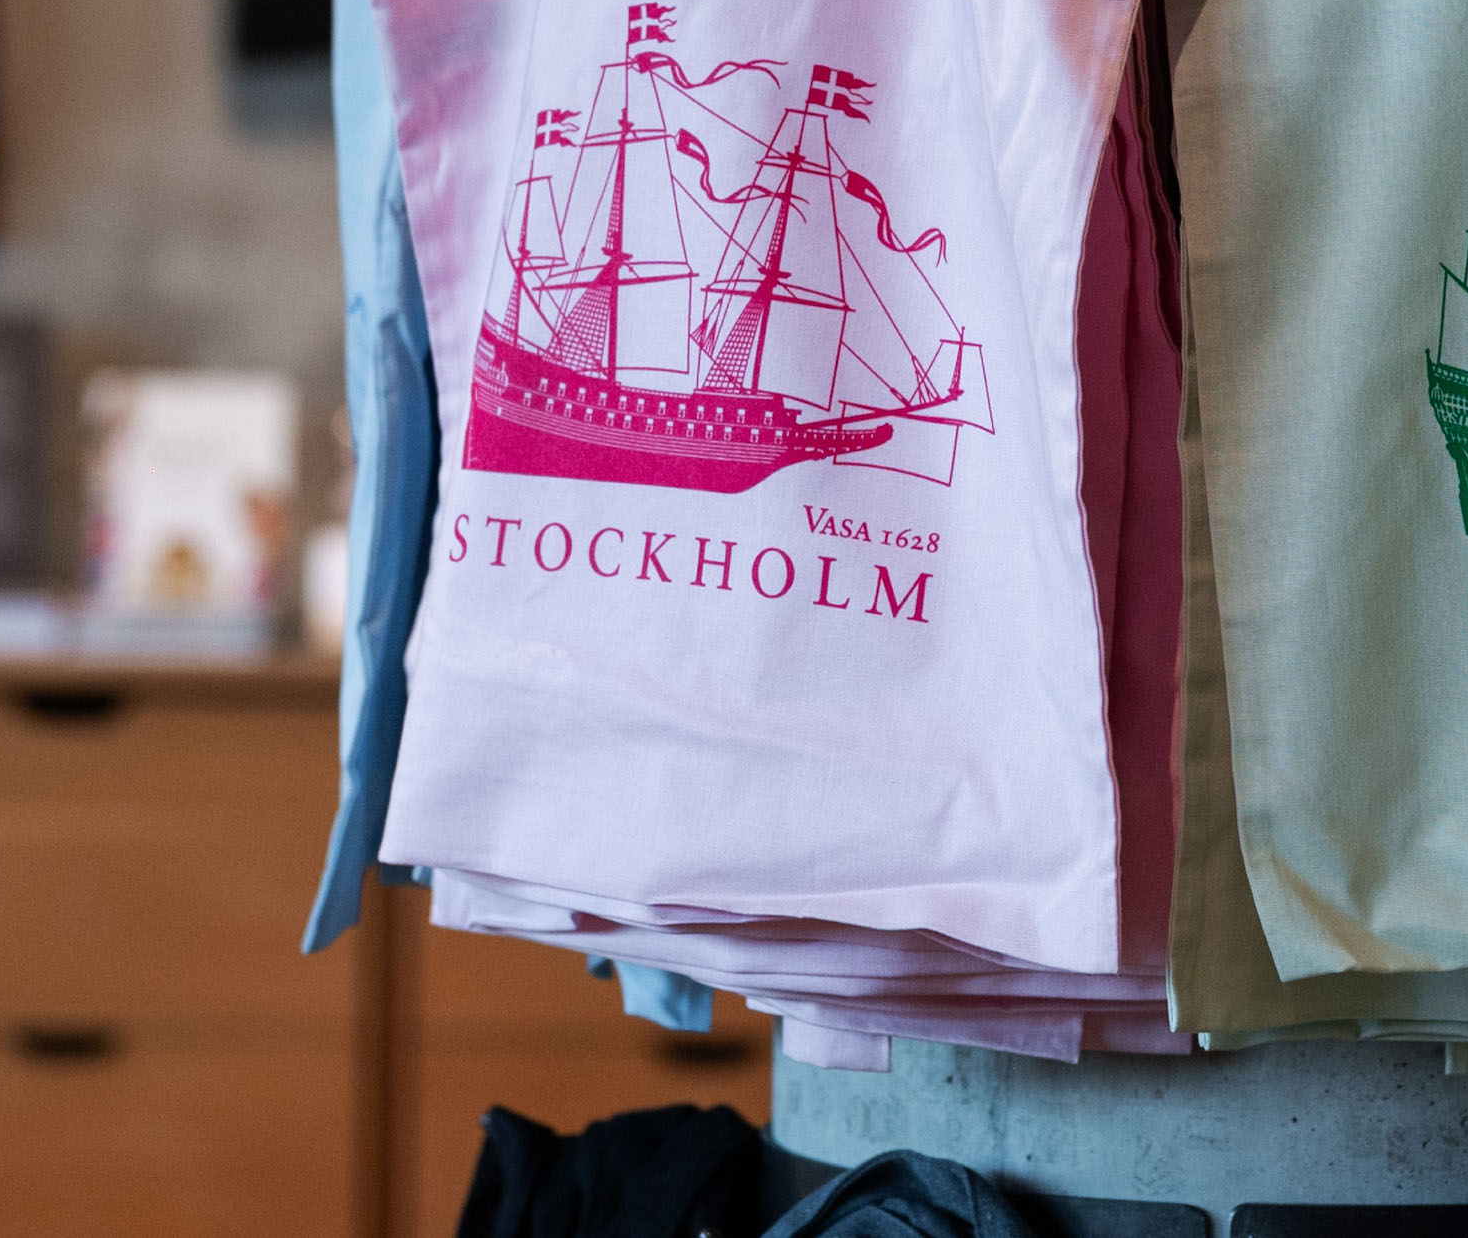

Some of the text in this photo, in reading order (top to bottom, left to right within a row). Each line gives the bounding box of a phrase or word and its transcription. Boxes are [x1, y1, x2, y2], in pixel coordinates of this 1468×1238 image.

[447, 513, 935, 624] STOCKHOLM
[803, 504, 940, 554] VASA 1628
